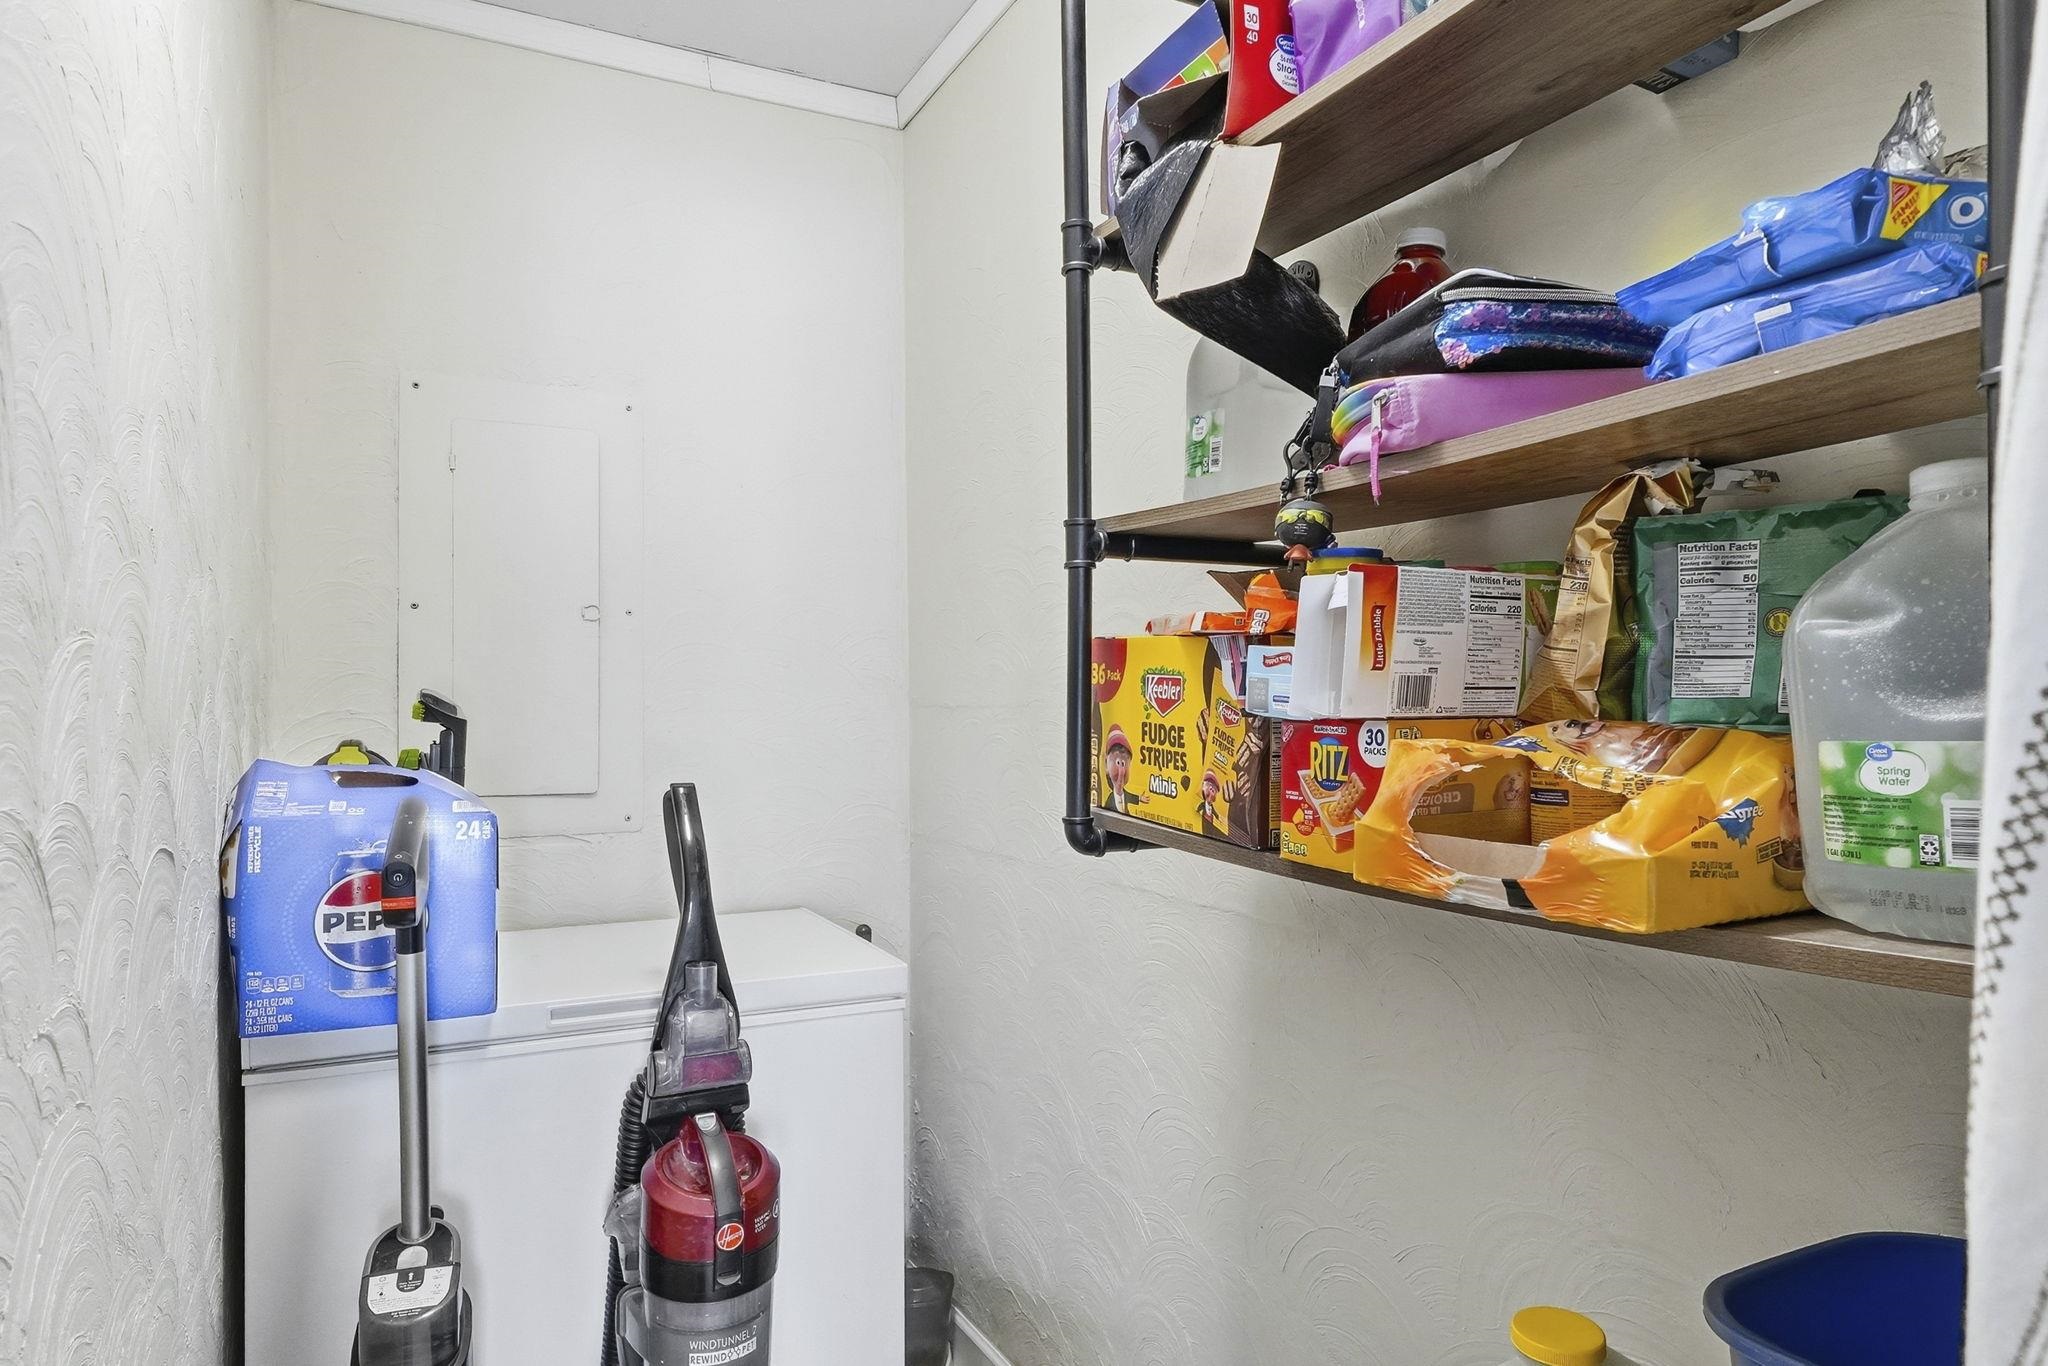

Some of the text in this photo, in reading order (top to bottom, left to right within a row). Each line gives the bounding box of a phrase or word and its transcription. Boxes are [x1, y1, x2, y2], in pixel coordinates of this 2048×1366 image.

[1680, 542, 1757, 553] Nutrition Facts
[1469, 575, 1521, 586] Nutrition Facts
[1507, 605, 1522, 614] 220
[1373, 608, 1384, 668] Little Debbie
[1147, 676, 1181, 702] Keebler
[1141, 722, 1185, 748] FUDGE
[1365, 728, 1385, 746] 30
[1140, 745, 1187, 772] STRIPES
[1310, 741, 1349, 782] RITZ
[1363, 747, 1387, 756] PACKS
[1877, 766, 1911, 777] Spring
[1879, 777, 1911, 786] Water
[1150, 774, 1177, 798] Minis
[455, 821, 480, 840] 24
[322, 910, 384, 933] PEP
[689, 1330, 750, 1350] WINDTUNNEL
[690, 1340, 756, 1365] REWIND PET
